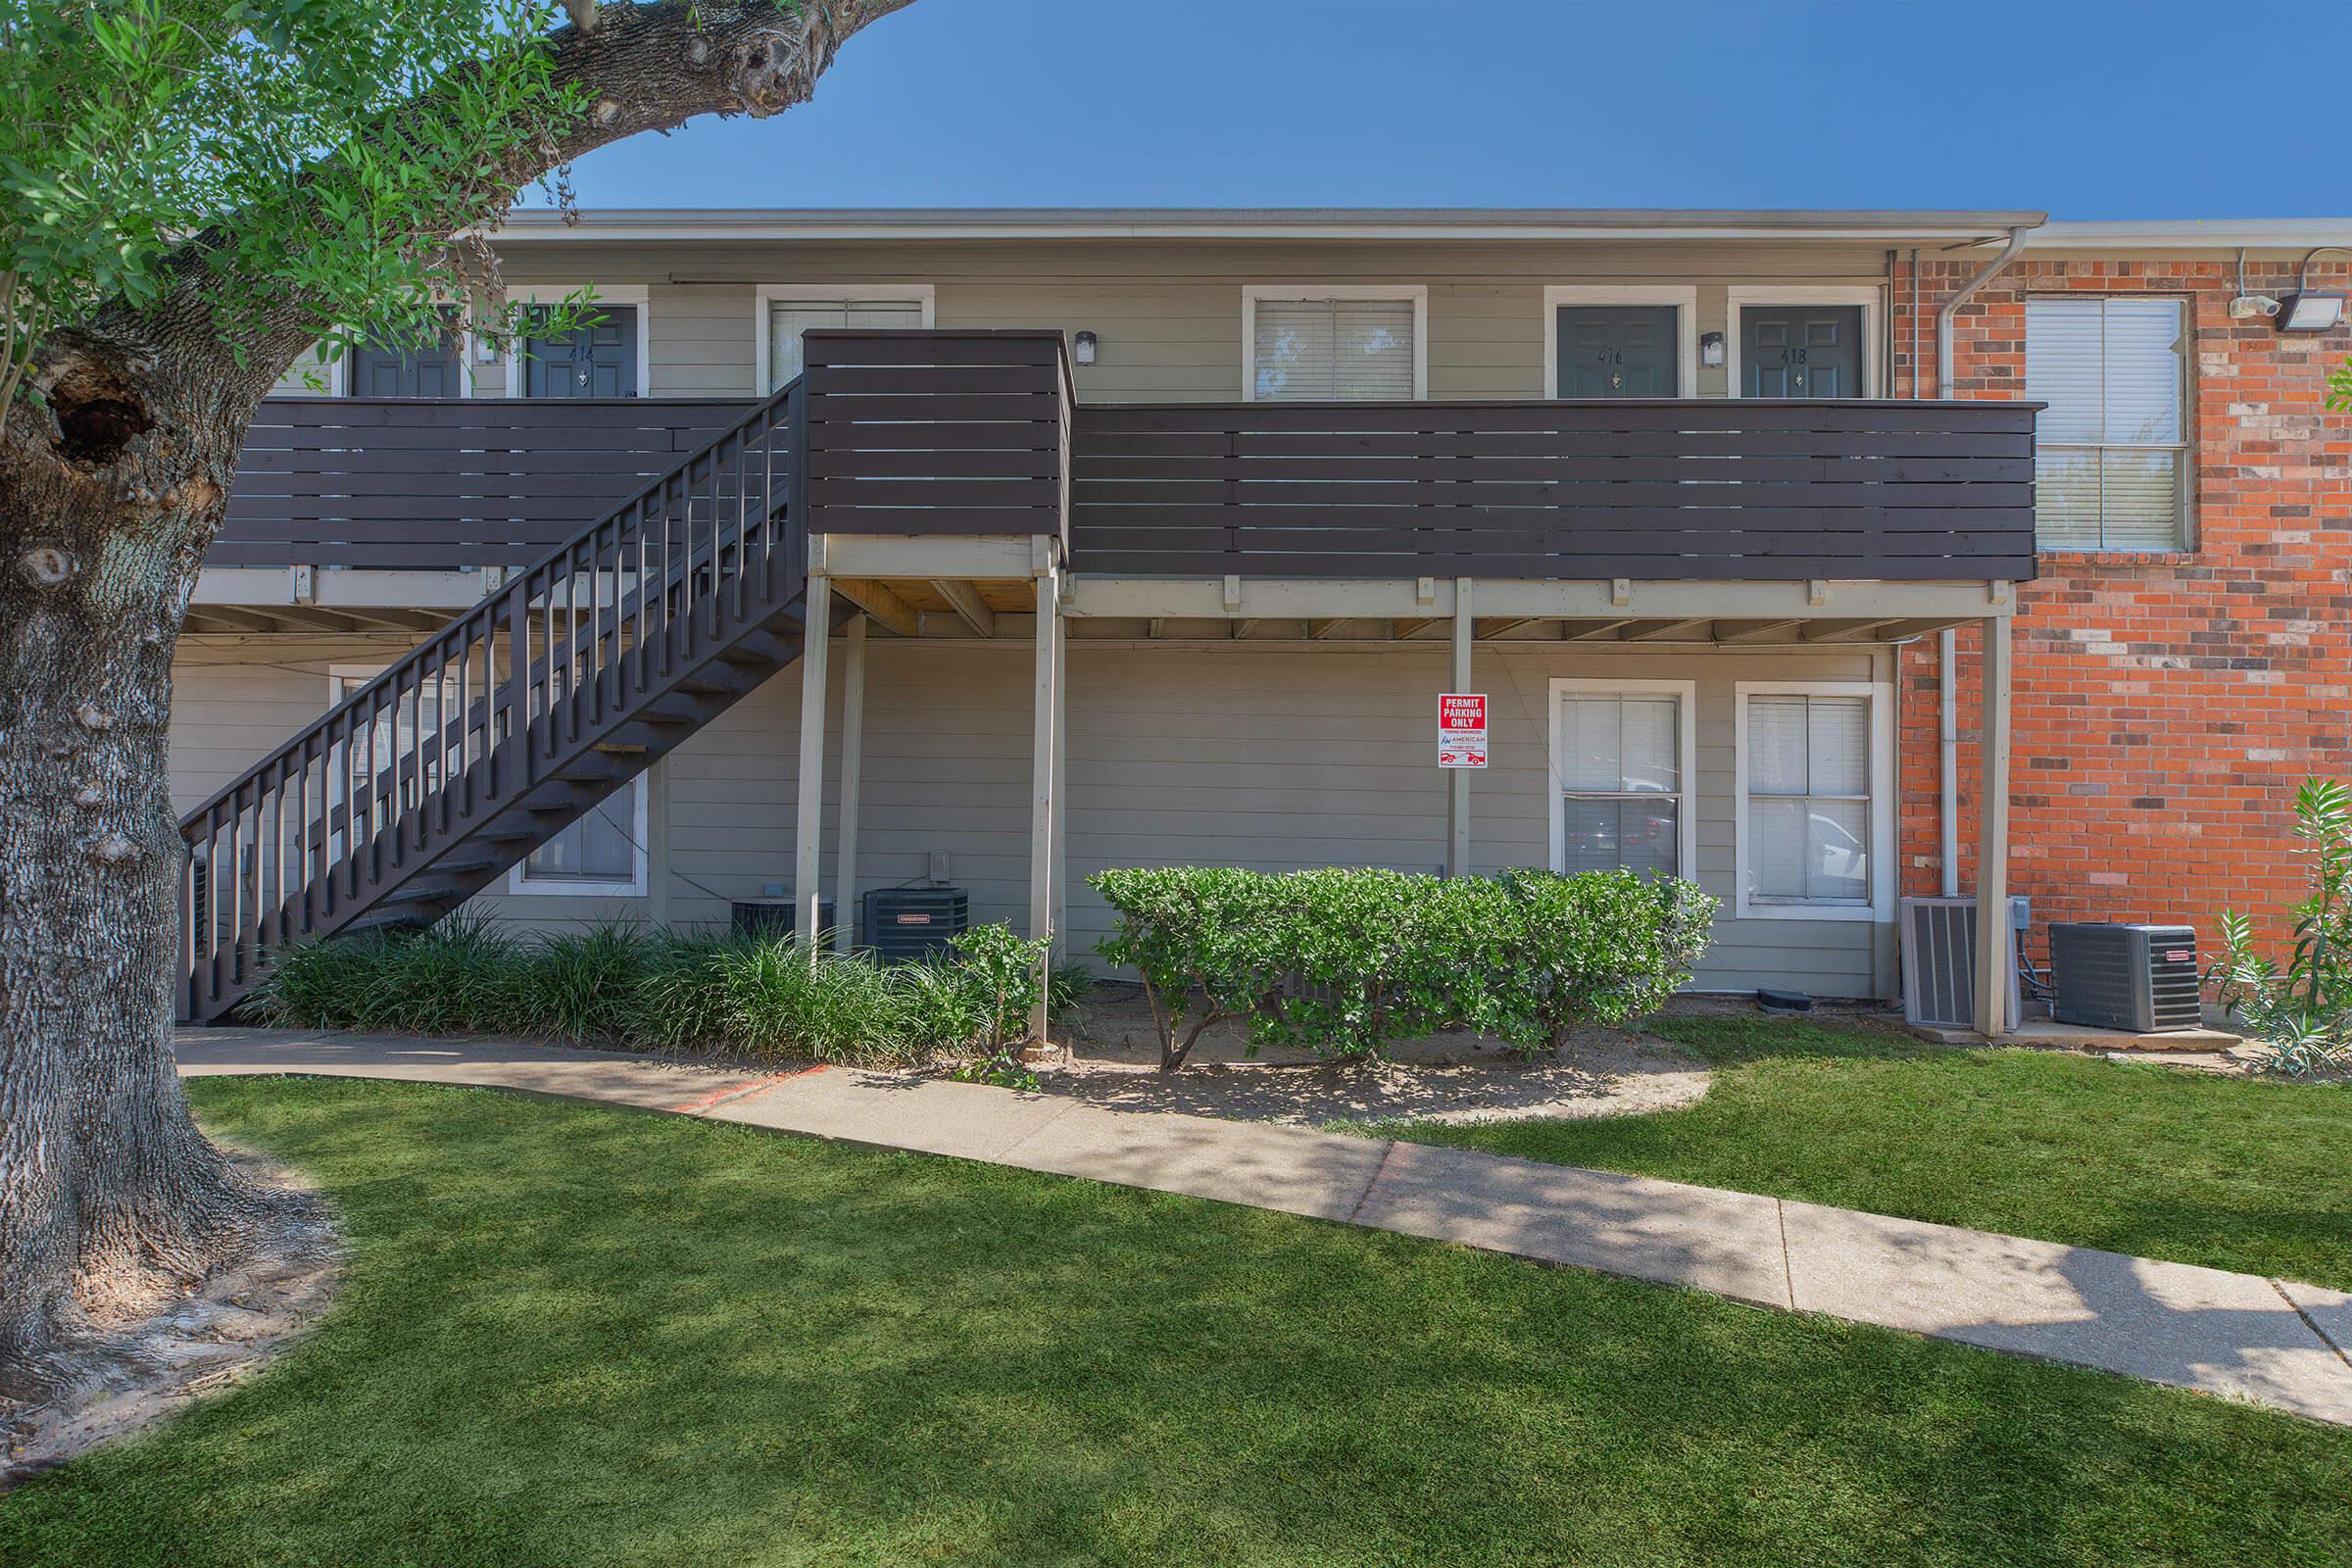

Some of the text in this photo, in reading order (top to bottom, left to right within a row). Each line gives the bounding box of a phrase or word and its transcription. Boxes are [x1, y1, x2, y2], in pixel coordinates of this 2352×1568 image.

[569, 346, 594, 362] 414
[1597, 347, 1623, 365] 416
[1781, 348, 1806, 365] 418
[1446, 699, 1480, 708] PERMIT
[1444, 709, 1482, 717] PARKING
[1451, 718, 1474, 727] ONLY
